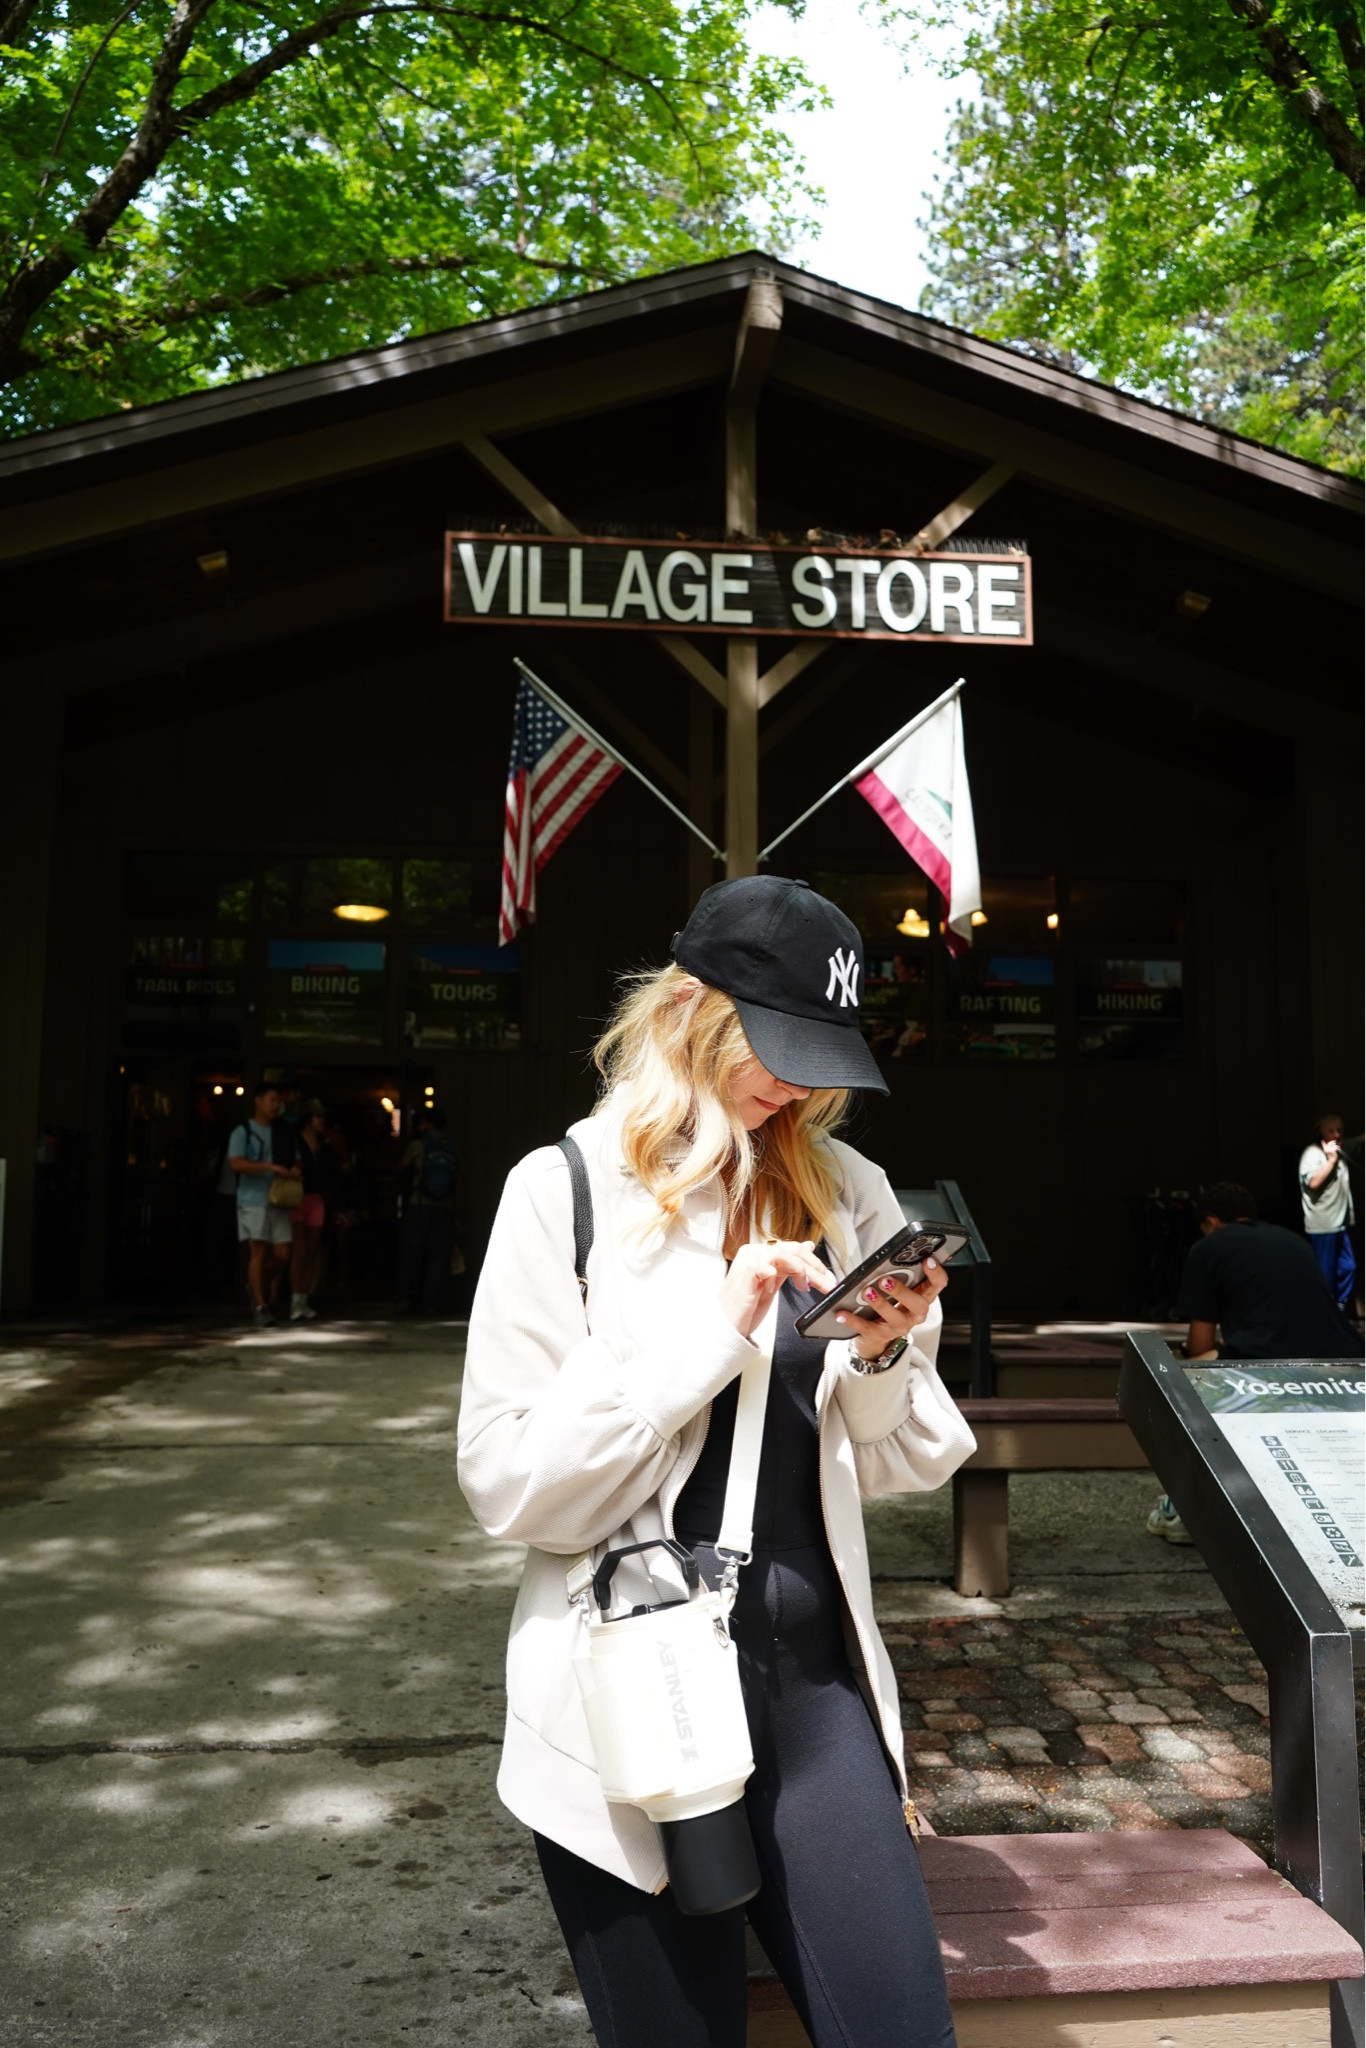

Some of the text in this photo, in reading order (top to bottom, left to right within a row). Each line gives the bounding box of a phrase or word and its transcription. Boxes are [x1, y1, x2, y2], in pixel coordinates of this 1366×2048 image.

[457, 542, 1021, 635] VILLAGE STORE
[135, 977, 236, 995] TRAIL RIDES
[290, 975, 361, 994] BIKING
[825, 947, 860, 1008] NY
[430, 982, 498, 1002] TOURS
[959, 995, 1041, 1014] RAFTING
[1096, 993, 1163, 1011] HIKING
[656, 1640, 694, 1742] STANLEY
